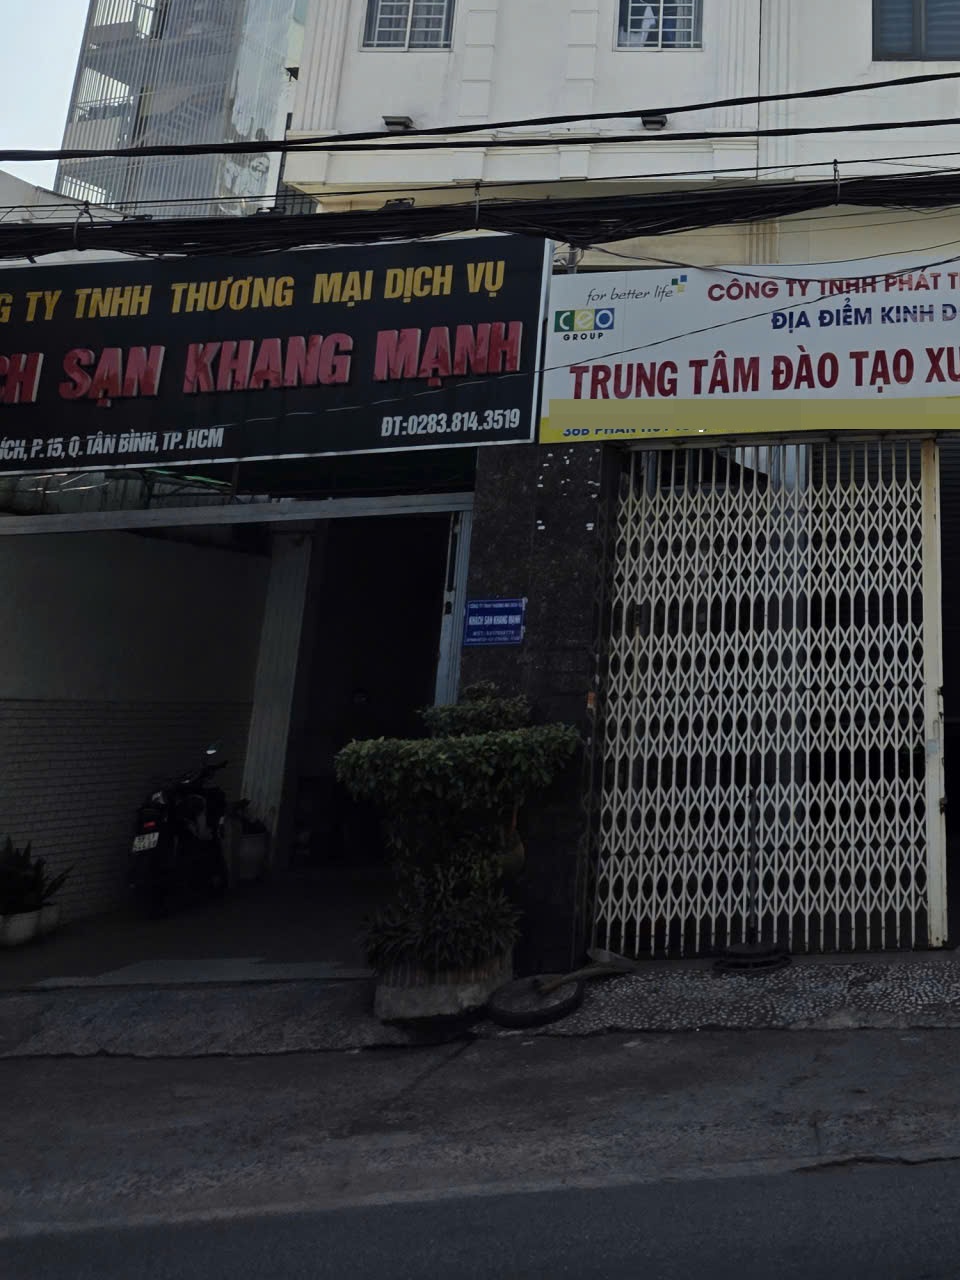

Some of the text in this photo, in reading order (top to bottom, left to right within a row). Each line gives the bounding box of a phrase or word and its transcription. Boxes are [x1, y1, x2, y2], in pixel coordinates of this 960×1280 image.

[25, 289, 62, 322] TY
[75, 285, 152, 319] TNHH
[171, 275, 295, 314] THƯƠNG
[312, 270, 374, 307] MẠI
[383, 264, 454, 304] DỊCH
[467, 260, 505, 298] VỤ
[586, 284, 674, 305] for better life
[707, 278, 779, 301] CÔNG
[785, 278, 809, 297] TY
[820, 276, 877, 296] TNHH
[884, 266, 942, 293] PHÁT
[771, 311, 811, 334] ĐỊA
[818, 297, 873, 328] ĐIỂM
[881, 304, 935, 324] KINH
[563, 332, 604, 341] GROUP
[58, 345, 165, 407] SẠN
[182, 332, 354, 394] KHANG
[372, 320, 523, 388] MẠNH
[569, 360, 679, 400] TRUNG
[689, 349, 760, 395] TÂM
[771, 345, 839, 391] ĐÀO
[849, 348, 914, 393] TẠO
[86, 430, 117, 455] TÂN
[117, 428, 159, 453] BÌNH,
